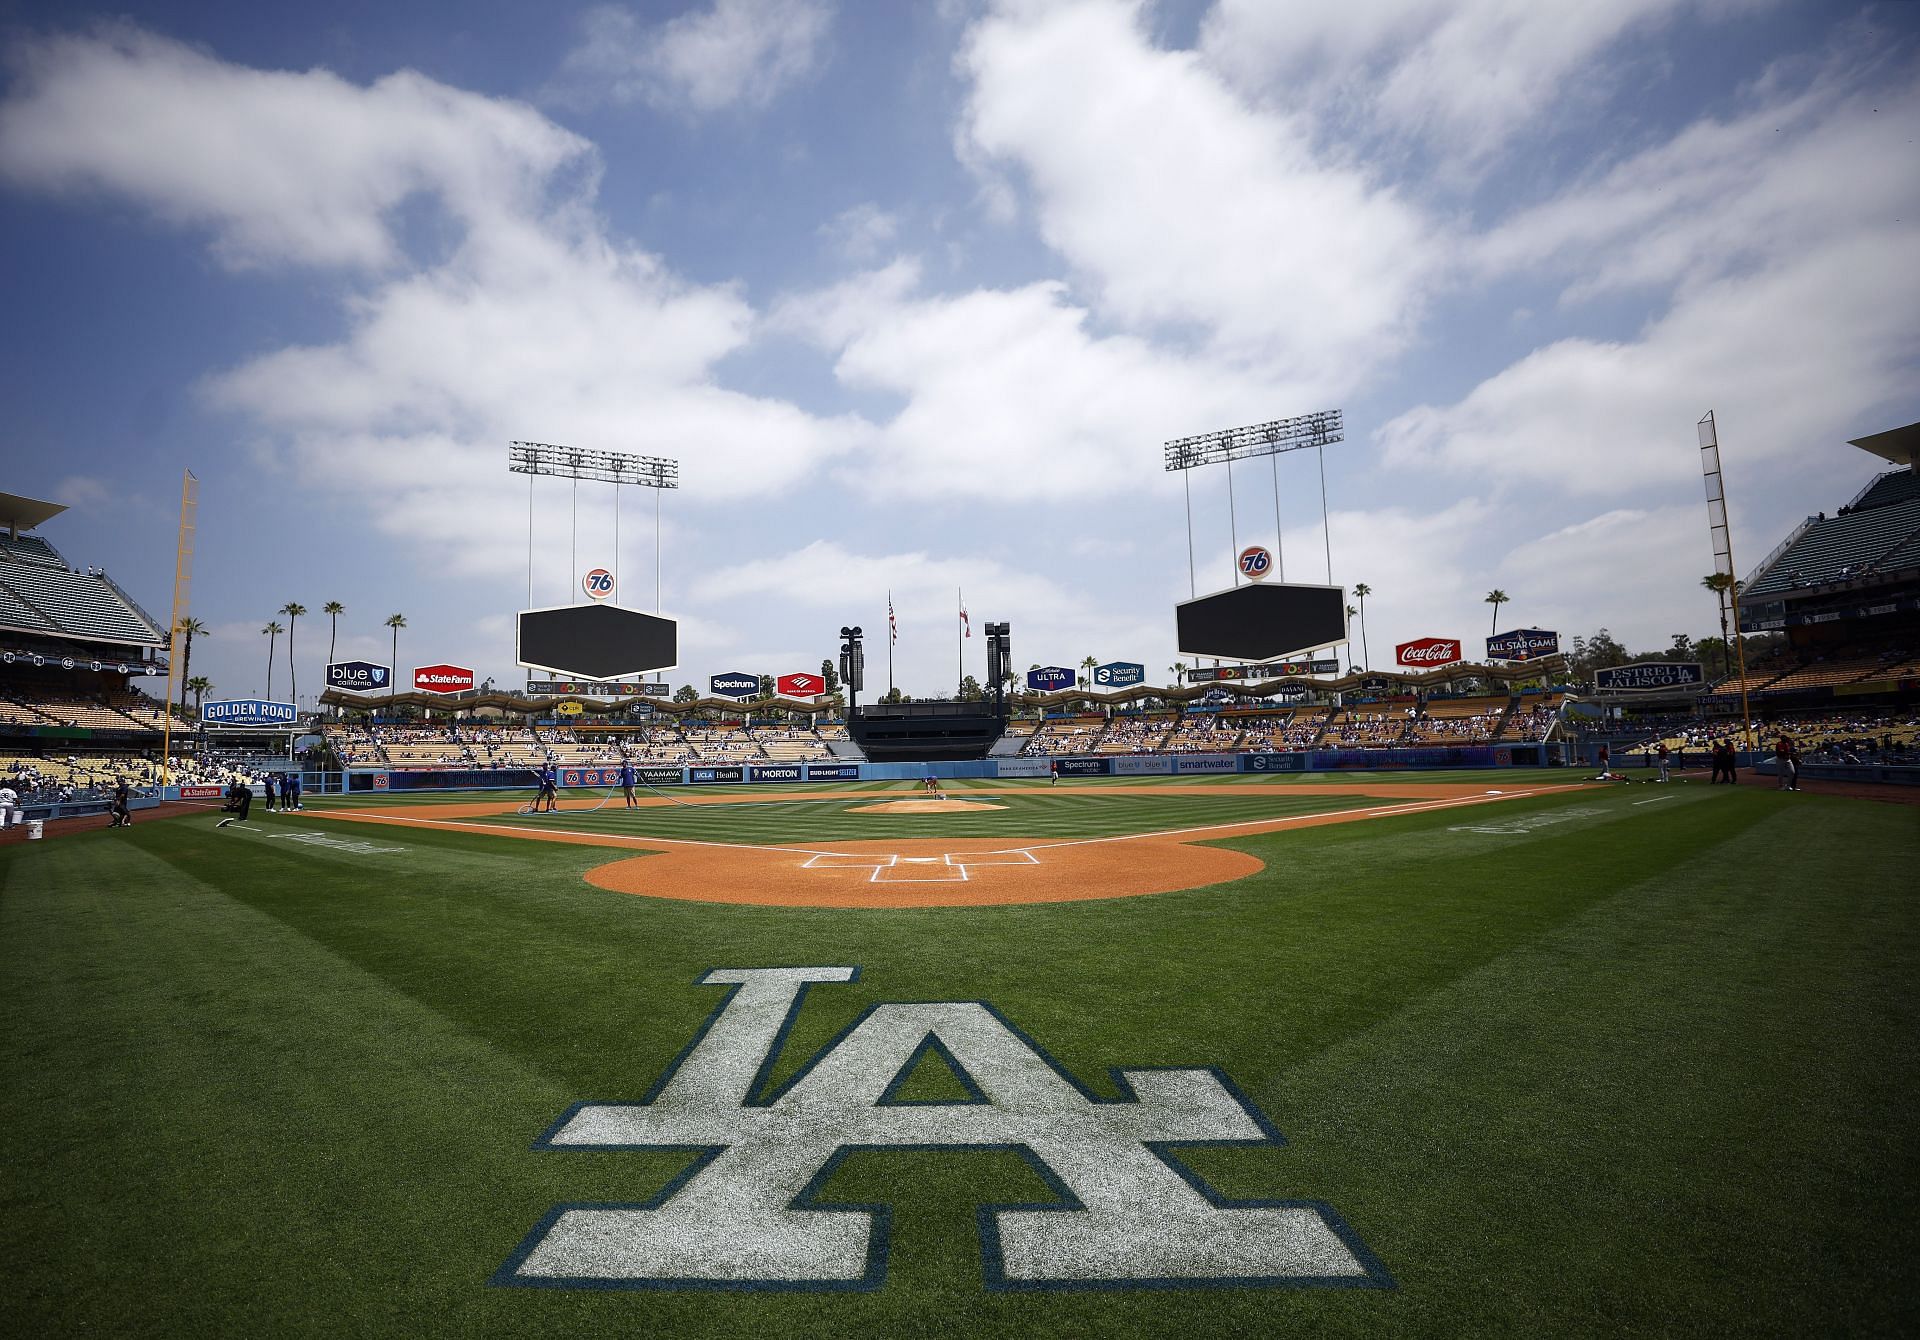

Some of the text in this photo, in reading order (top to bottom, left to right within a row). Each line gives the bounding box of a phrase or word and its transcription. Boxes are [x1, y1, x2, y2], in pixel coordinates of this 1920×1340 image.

[1243, 551, 1268, 572] 76
[590, 574, 611, 591] 76
[1489, 638, 1556, 651] ALL STAR GAME
[4, 653, 14, 661] 32
[1401, 643, 1455, 662] Coca-Cola
[332, 666, 368, 680] blue
[1112, 667, 1140, 676] Security
[1611, 666, 1676, 679] ESTREL
[1037, 673, 1066, 681] ULTRA
[1113, 674, 1137, 682] Benefit
[1605, 675, 1673, 688] JALISCO
[713, 680, 754, 689] Spectrum
[1281, 685, 1304, 693] DASANI
[208, 703, 292, 720] GOLDEN ROAD
[1268, 755, 1295, 763] Security
[1064, 761, 1099, 770] Spectrum
[1144, 760, 1160, 768] blue
[1180, 760, 1235, 769] smartwater
[567, 774, 578, 782] 76
[587, 774, 597, 782] 76
[606, 773, 616, 781] 76
[716, 771, 739, 779] Health
[762, 769, 797, 778] MORTON
[375, 777, 387, 785] 76
[500, 966, 1384, 1285] LA
